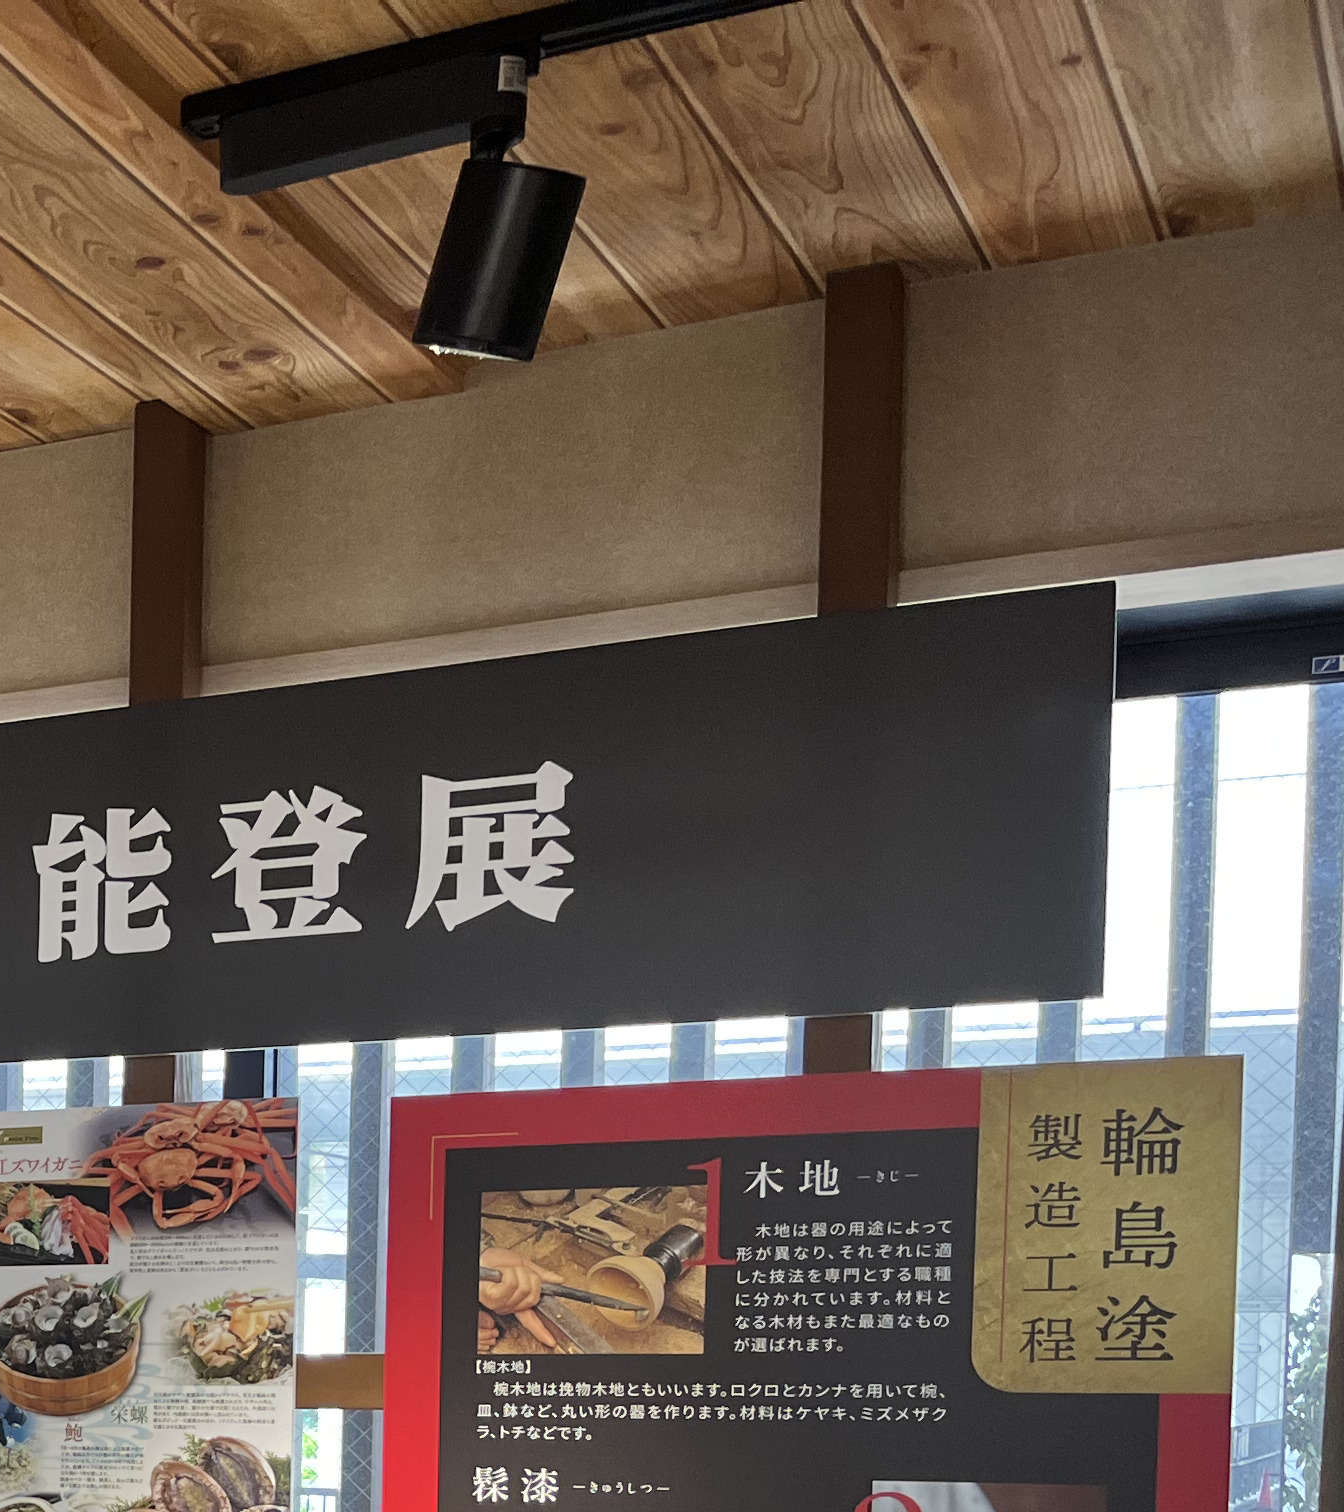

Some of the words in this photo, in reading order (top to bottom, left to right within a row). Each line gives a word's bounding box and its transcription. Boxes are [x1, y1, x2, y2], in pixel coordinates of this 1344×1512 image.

[743, 1159, 841, 1199] 木地
[687, 1156, 737, 1268] 1
[755, 1219, 953, 1239] 木地は器の用途によって
[1019, 1112, 1084, 1364] 製造工程
[1095, 1106, 1185, 1362] 輪島塗
[735, 1242, 952, 1263] 形が異なり、それぞれに適
[735, 1265, 952, 1286] した技法を専門とする職種
[734, 1289, 952, 1308] に分かれています。材料と
[734, 1312, 950, 1331] なる木材もまた最適なもの
[733, 1336, 845, 1354] が選ばれます。
[473, 1359, 534, 1376] 【椀木地】
[493, 1381, 946, 1401] 椀木地は挽物木地ともいいます。ロクロとカンナを用いて椀、
[476, 1402, 948, 1423] 皿、鉢など、丸い形の器を作ります。材料はケヤキ、ミズメザク
[64, 1423, 84, 1443] 鮑
[476, 1424, 594, 1441] ラ、トチなどです。
